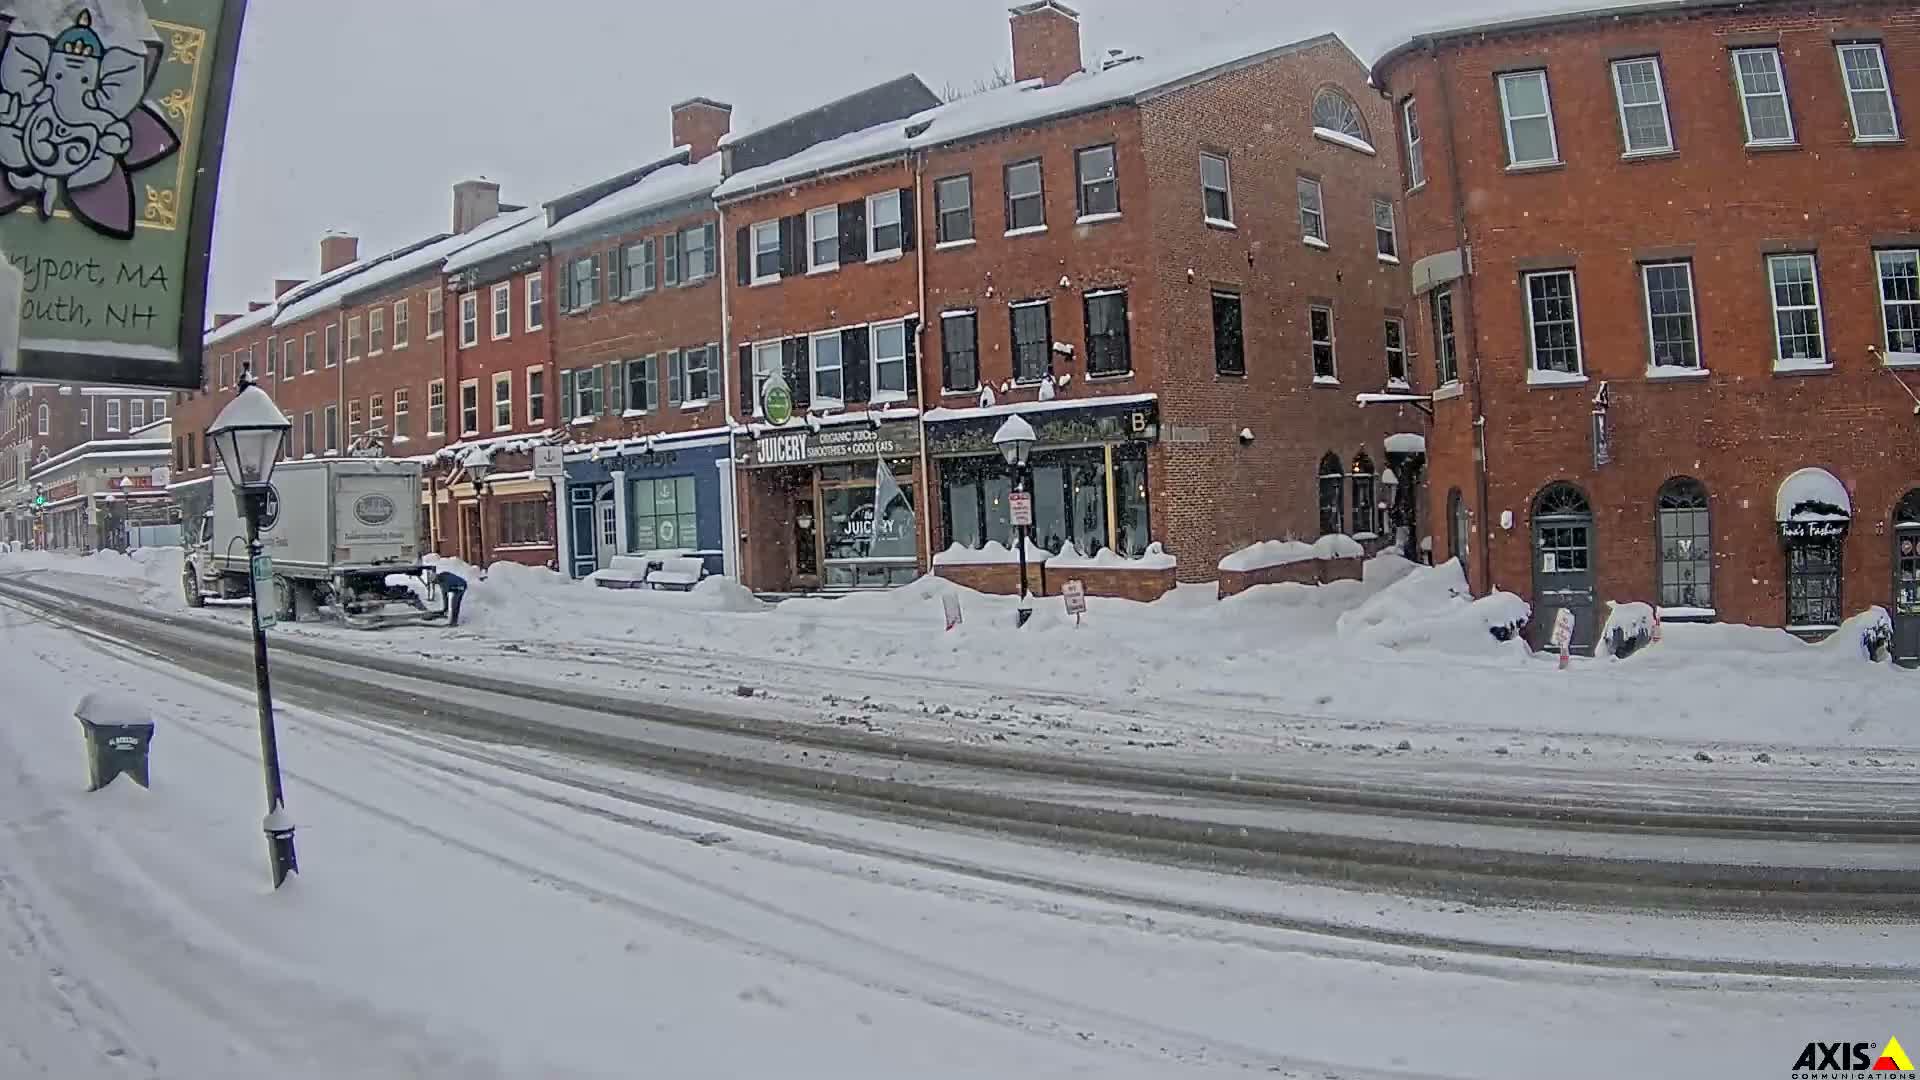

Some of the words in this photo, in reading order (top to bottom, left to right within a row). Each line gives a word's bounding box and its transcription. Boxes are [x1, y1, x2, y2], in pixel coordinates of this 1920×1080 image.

[116, 262, 169, 291] MA
[105, 304, 158, 330] NH
[1131, 412, 1145, 432] B
[807, 447, 847, 457] SMOOTHIES
[852, 442, 875, 454] GOOD
[876, 440, 894, 451] EATS
[819, 431, 851, 444] ORGANIC
[853, 430, 878, 441] JUICES
[757, 435, 807, 463] JUICERY
